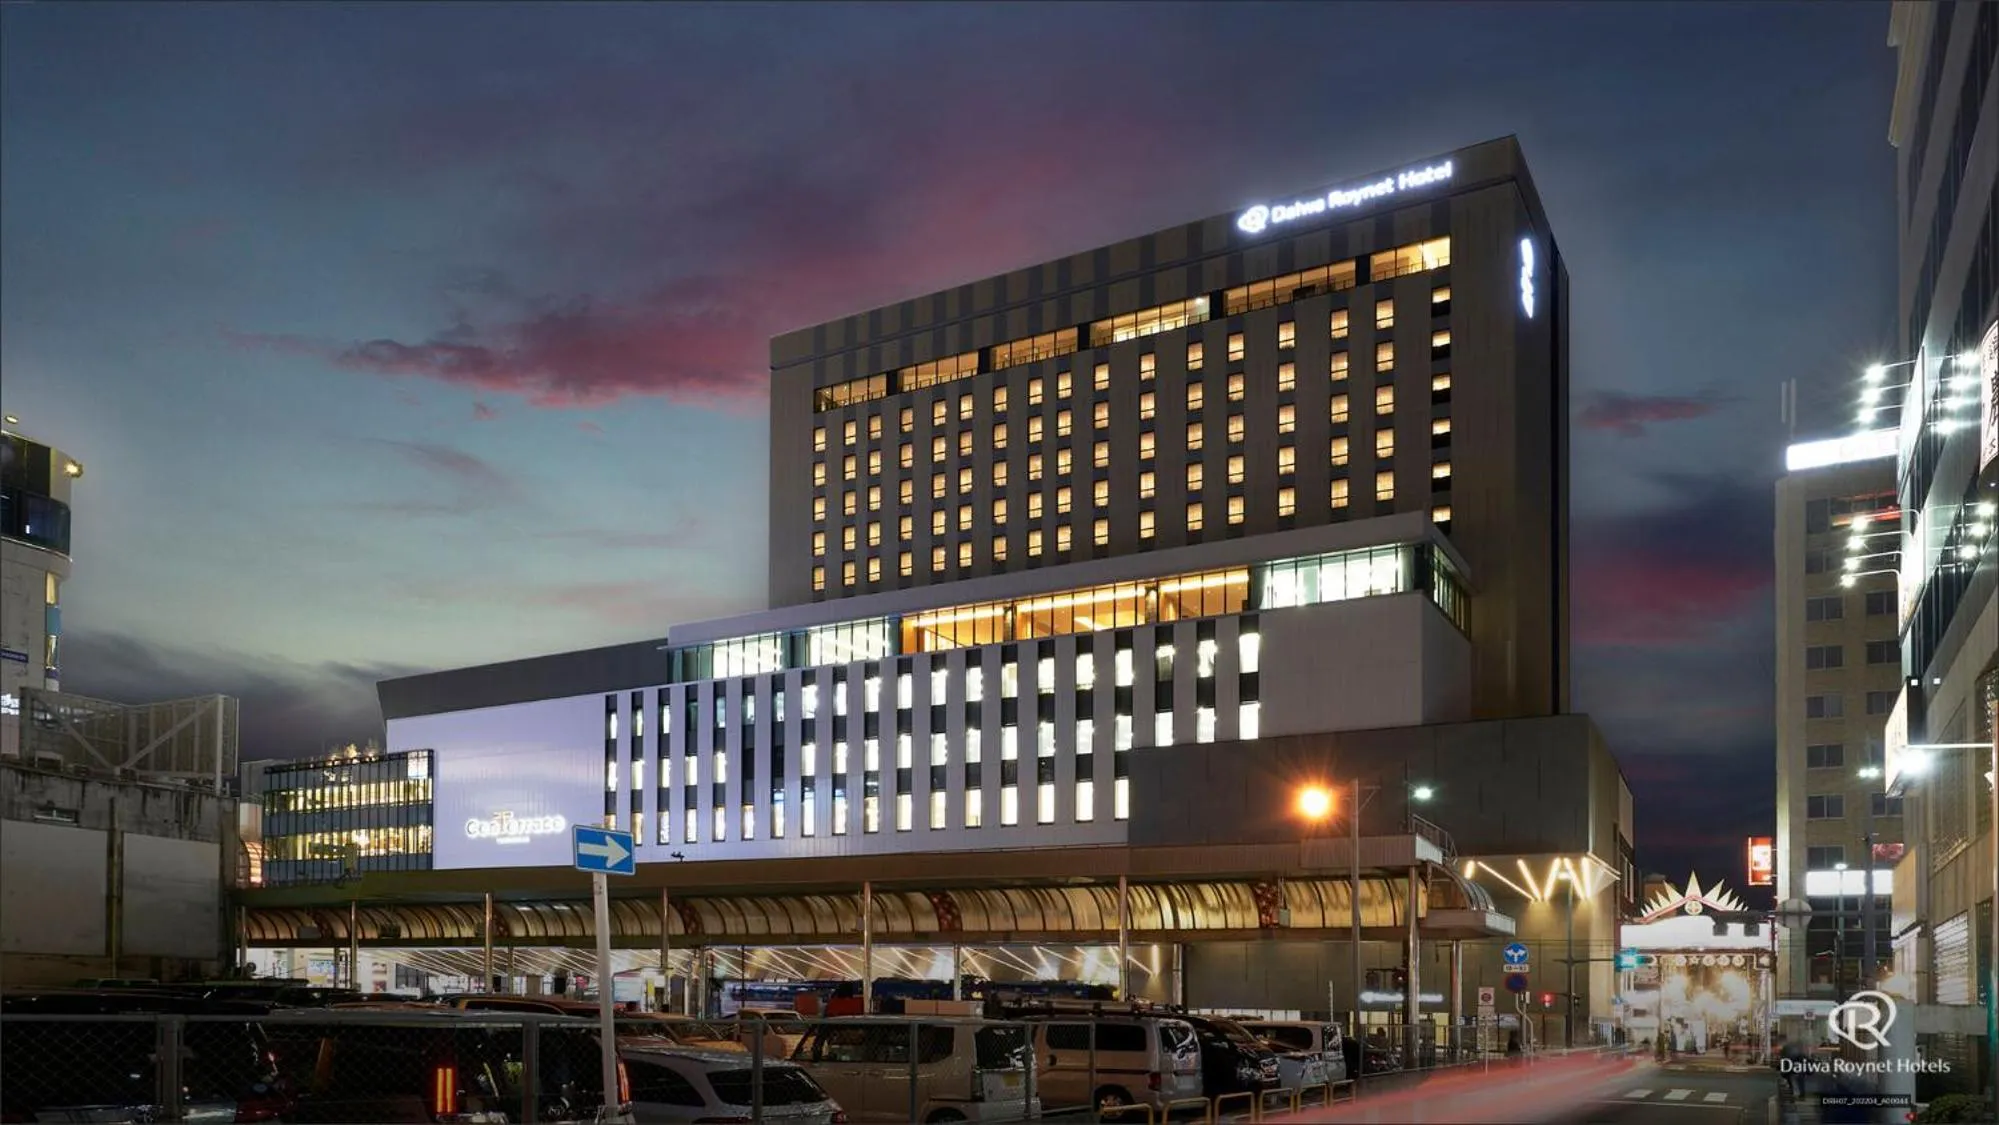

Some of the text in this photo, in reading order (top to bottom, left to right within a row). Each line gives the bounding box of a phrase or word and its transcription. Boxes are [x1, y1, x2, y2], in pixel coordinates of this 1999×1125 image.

[1271, 199, 1326, 224] Daiwa
[1328, 176, 1395, 209] Roynet
[1398, 160, 1453, 190] Hotel
